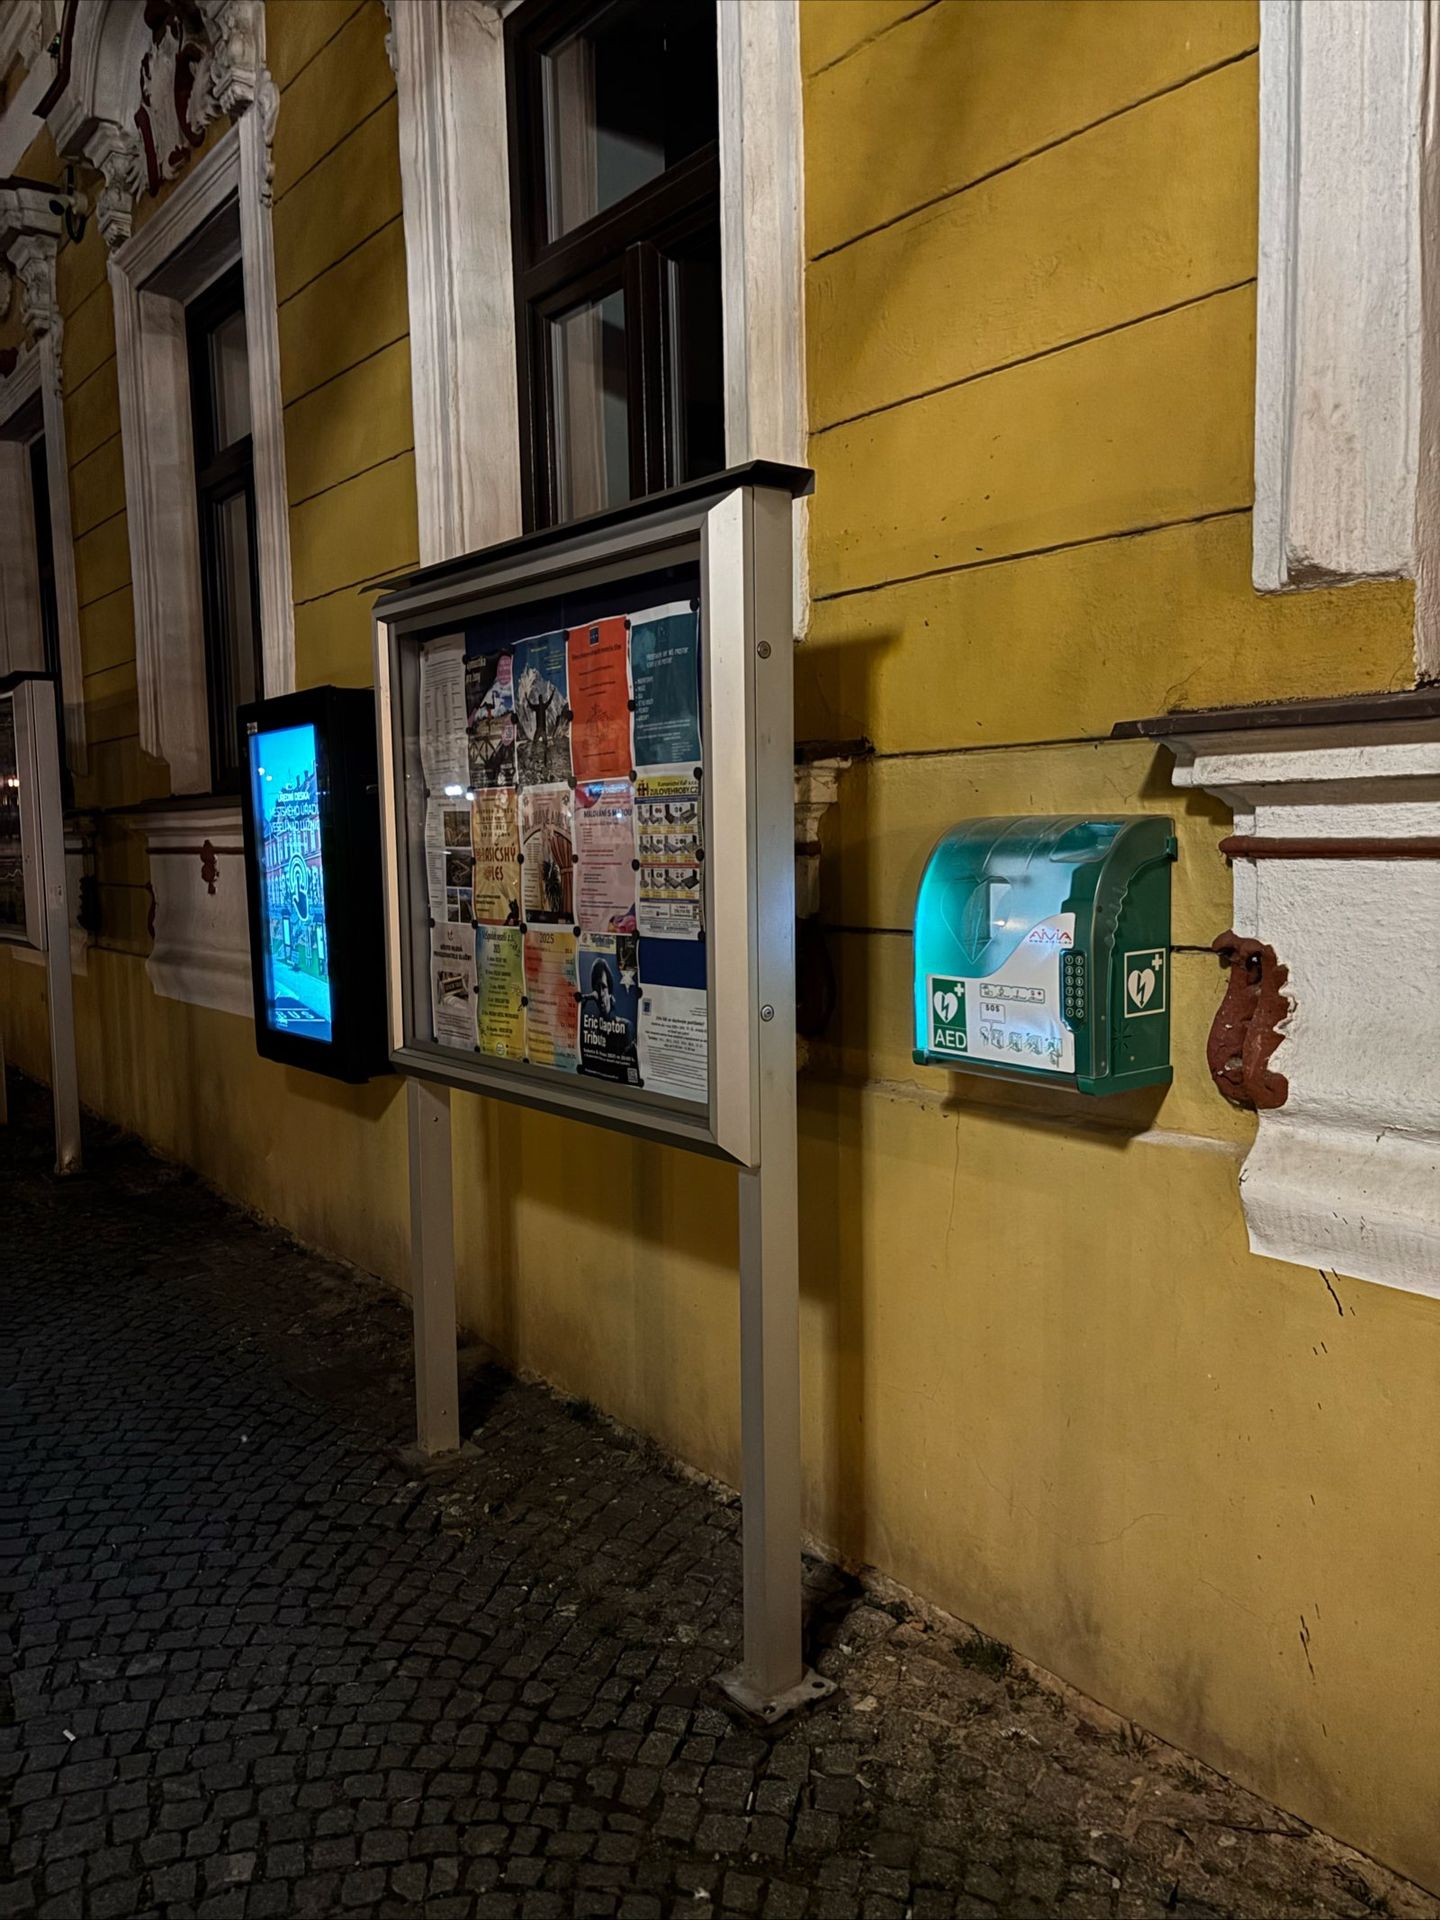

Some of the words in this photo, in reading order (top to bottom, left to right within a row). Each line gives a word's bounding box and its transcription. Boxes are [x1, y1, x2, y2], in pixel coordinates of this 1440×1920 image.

[539, 933, 554, 944] 2025
[985, 1004, 1000, 1012] SOS
[583, 1014, 599, 1029] Eric
[583, 1030, 607, 1047] Tribute
[935, 1029, 967, 1049] AED
